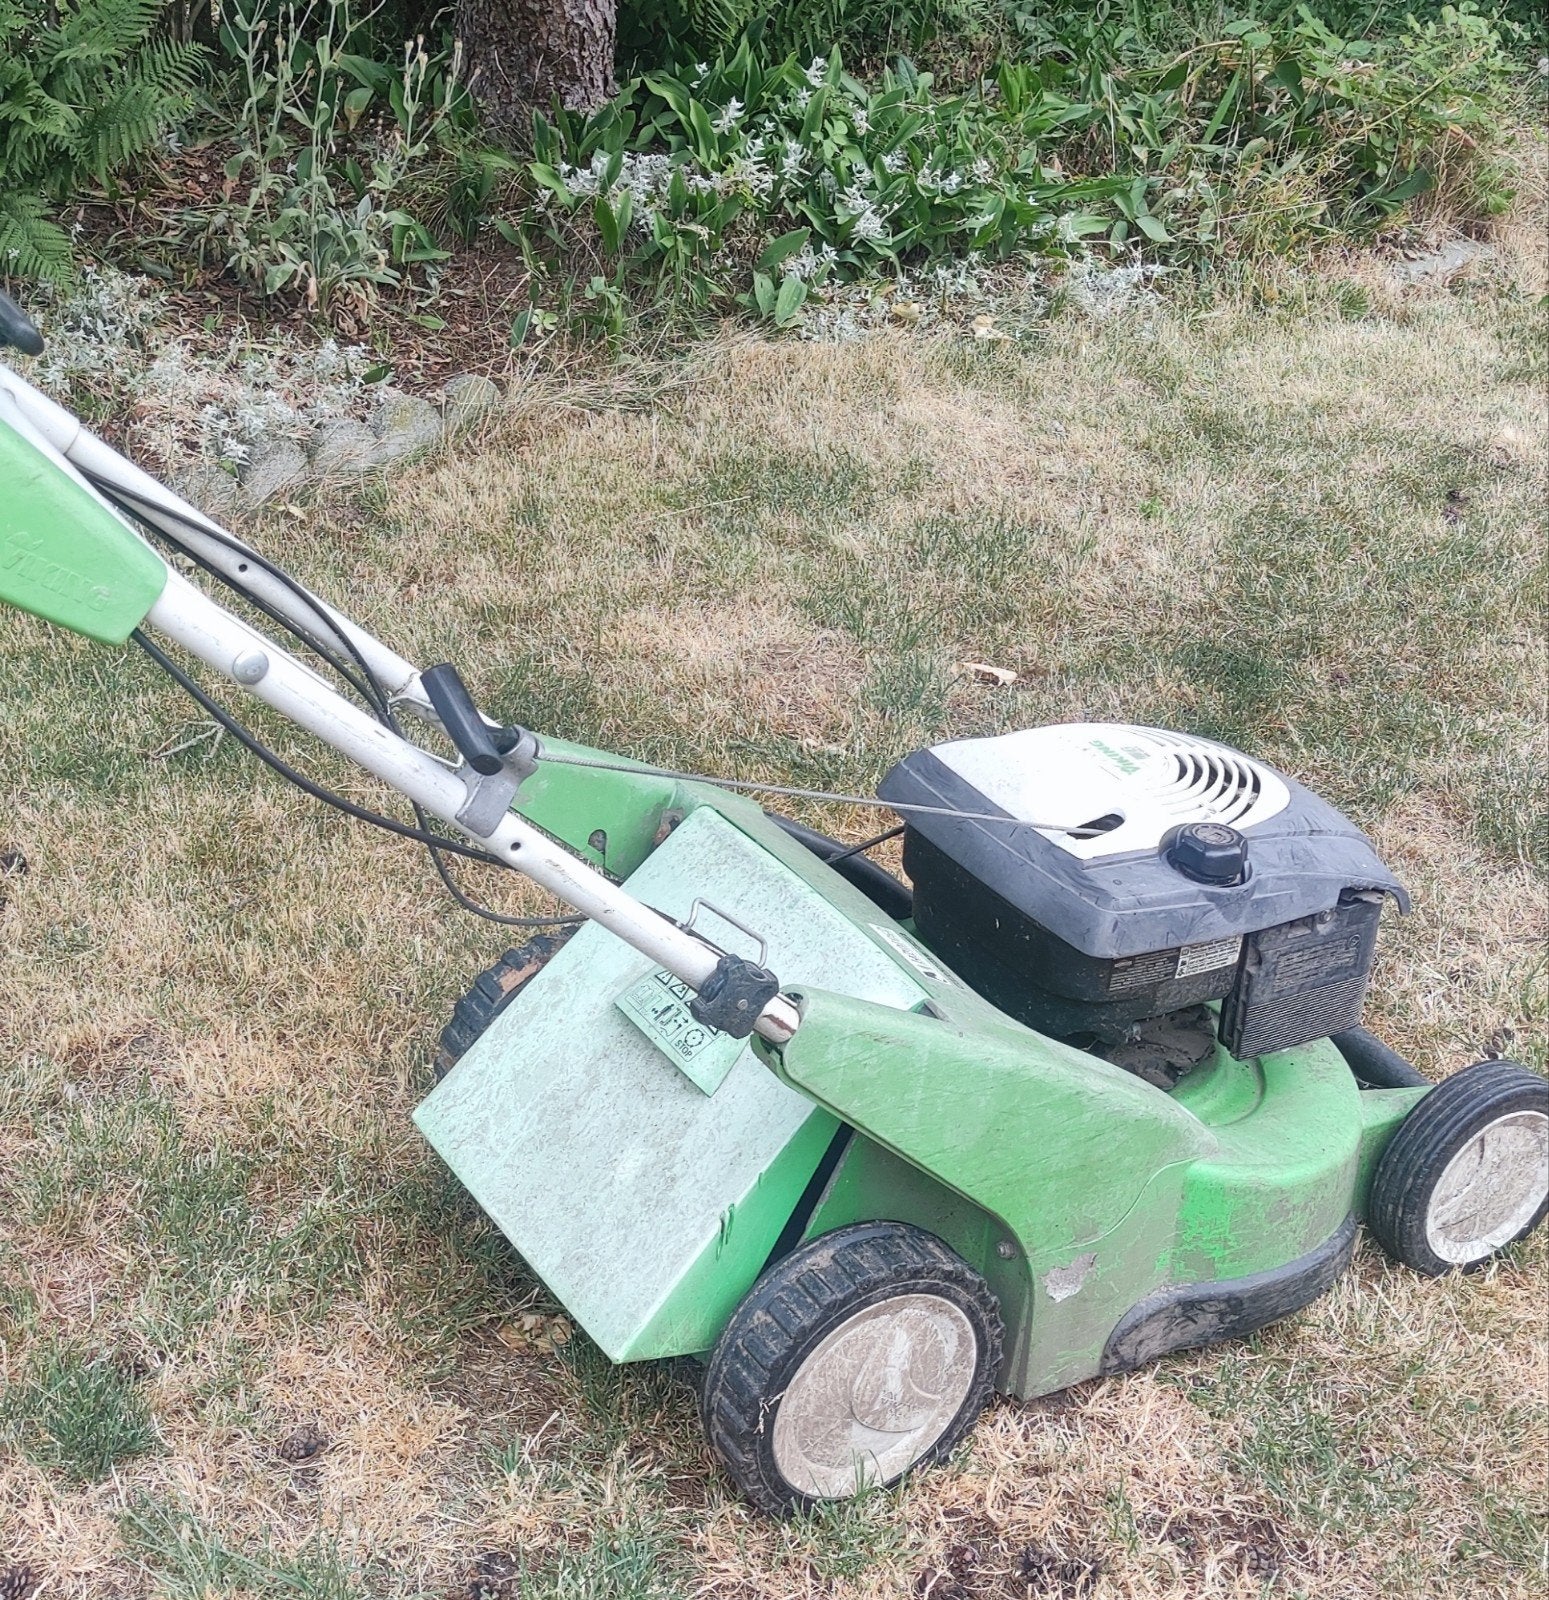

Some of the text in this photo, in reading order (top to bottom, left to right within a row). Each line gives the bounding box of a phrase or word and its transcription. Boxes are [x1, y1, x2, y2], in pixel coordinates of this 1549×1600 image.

[1, 543, 112, 612] VIKING
[1088, 740, 1141, 775] VIKING
[674, 1039, 693, 1057] STOP
